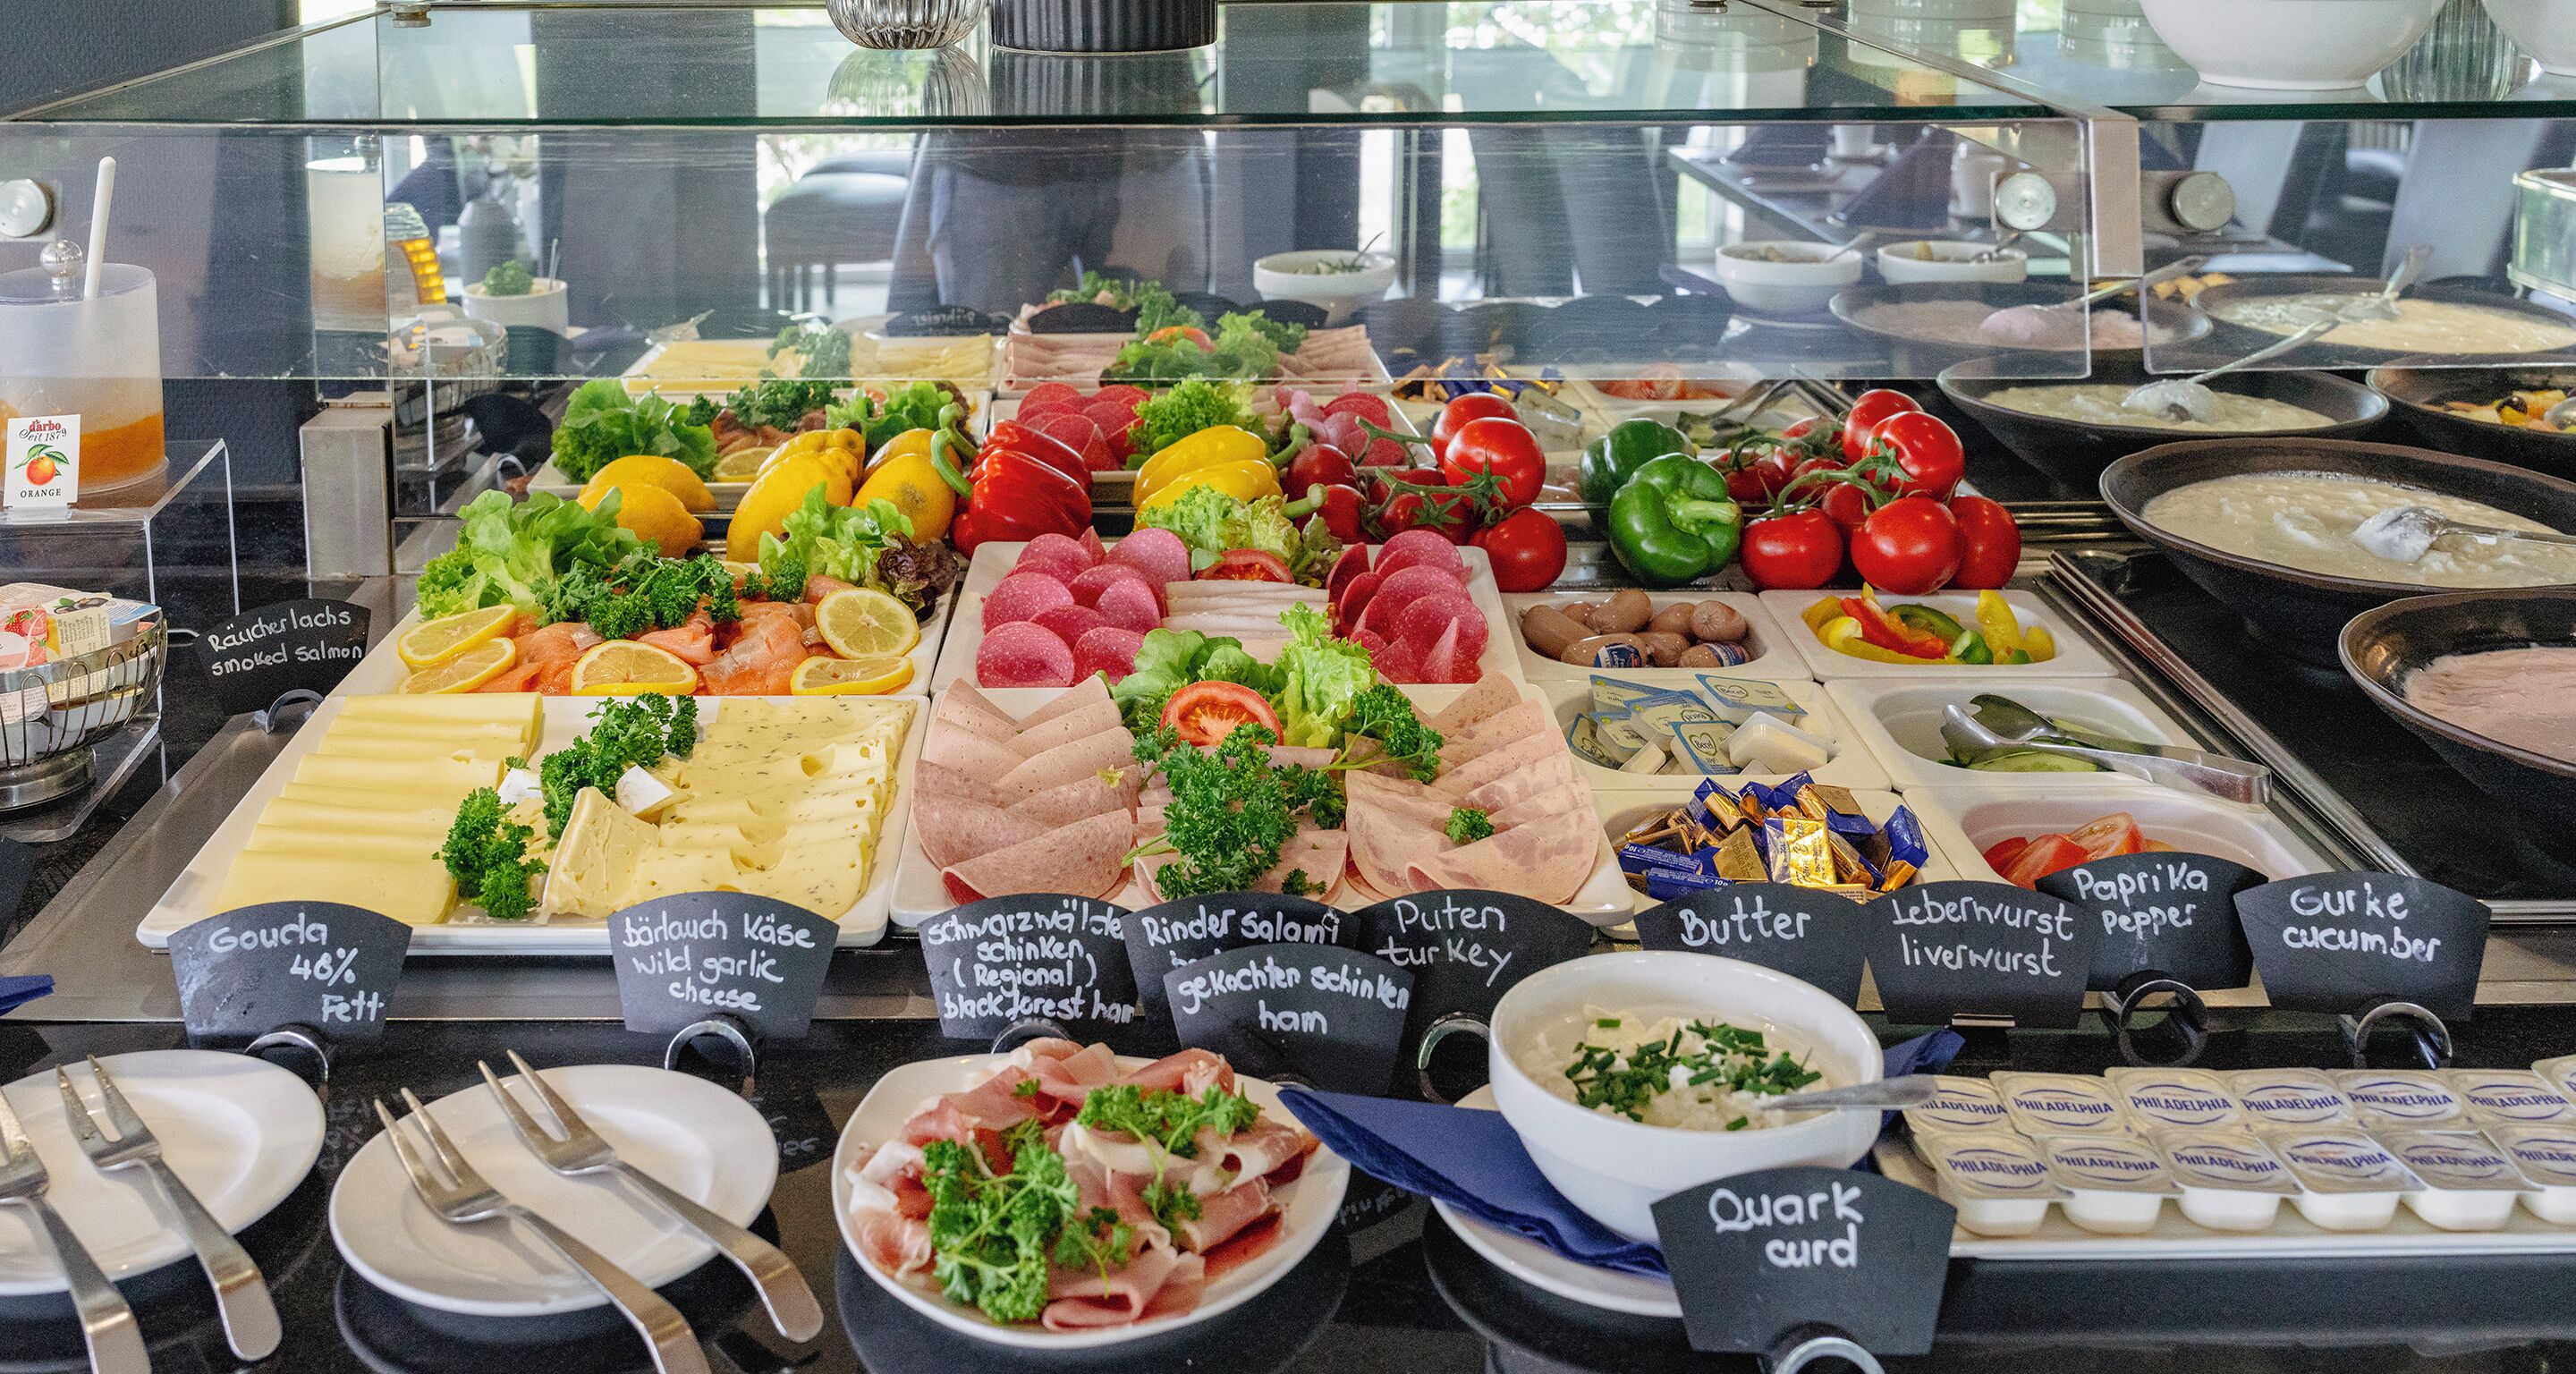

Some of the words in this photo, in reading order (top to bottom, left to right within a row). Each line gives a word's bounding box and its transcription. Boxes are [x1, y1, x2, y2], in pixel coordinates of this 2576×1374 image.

[19, 429, 43, 442] Seit
[45, 428, 67, 442] 1879
[20, 488, 62, 498] ORANGE
[211, 642, 288, 676] smoked
[1394, 895, 1506, 933] Puten
[2290, 881, 2409, 920] Gurke
[208, 912, 328, 954] Gouda
[743, 912, 816, 949] Käse
[1141, 904, 1236, 947] Rinder
[1679, 895, 1811, 946] Butter
[2102, 903, 2197, 940] pepper
[1901, 933, 2062, 977] liverwurst
[2283, 926, 2442, 963] cucumber
[290, 947, 359, 988] 48%
[699, 948, 784, 985] garlic
[322, 990, 386, 1023] Fett
[668, 976, 762, 1012] cheese
[944, 990, 1005, 1020] black
[1004, 986, 1086, 1022] forest
[1258, 999, 1328, 1035] ham
[2013, 1097, 2114, 1115] PHILADELPHIA
[2130, 1095, 2233, 1112] PHILADELPHIA
[2240, 1094, 2343, 1113] PHILADELPHIA
[2346, 1091, 2453, 1107] PHILADELPHIA
[2465, 1093, 2570, 1108] PHILADELPHIA
[1946, 1158, 2047, 1177] PHILADELPHIA
[2055, 1154, 2160, 1172] PHILADELPHIA
[2173, 1151, 2280, 1174] PHILADELPHIA
[1708, 1181, 1864, 1233] Quark
[1764, 1222, 1859, 1268] curd
